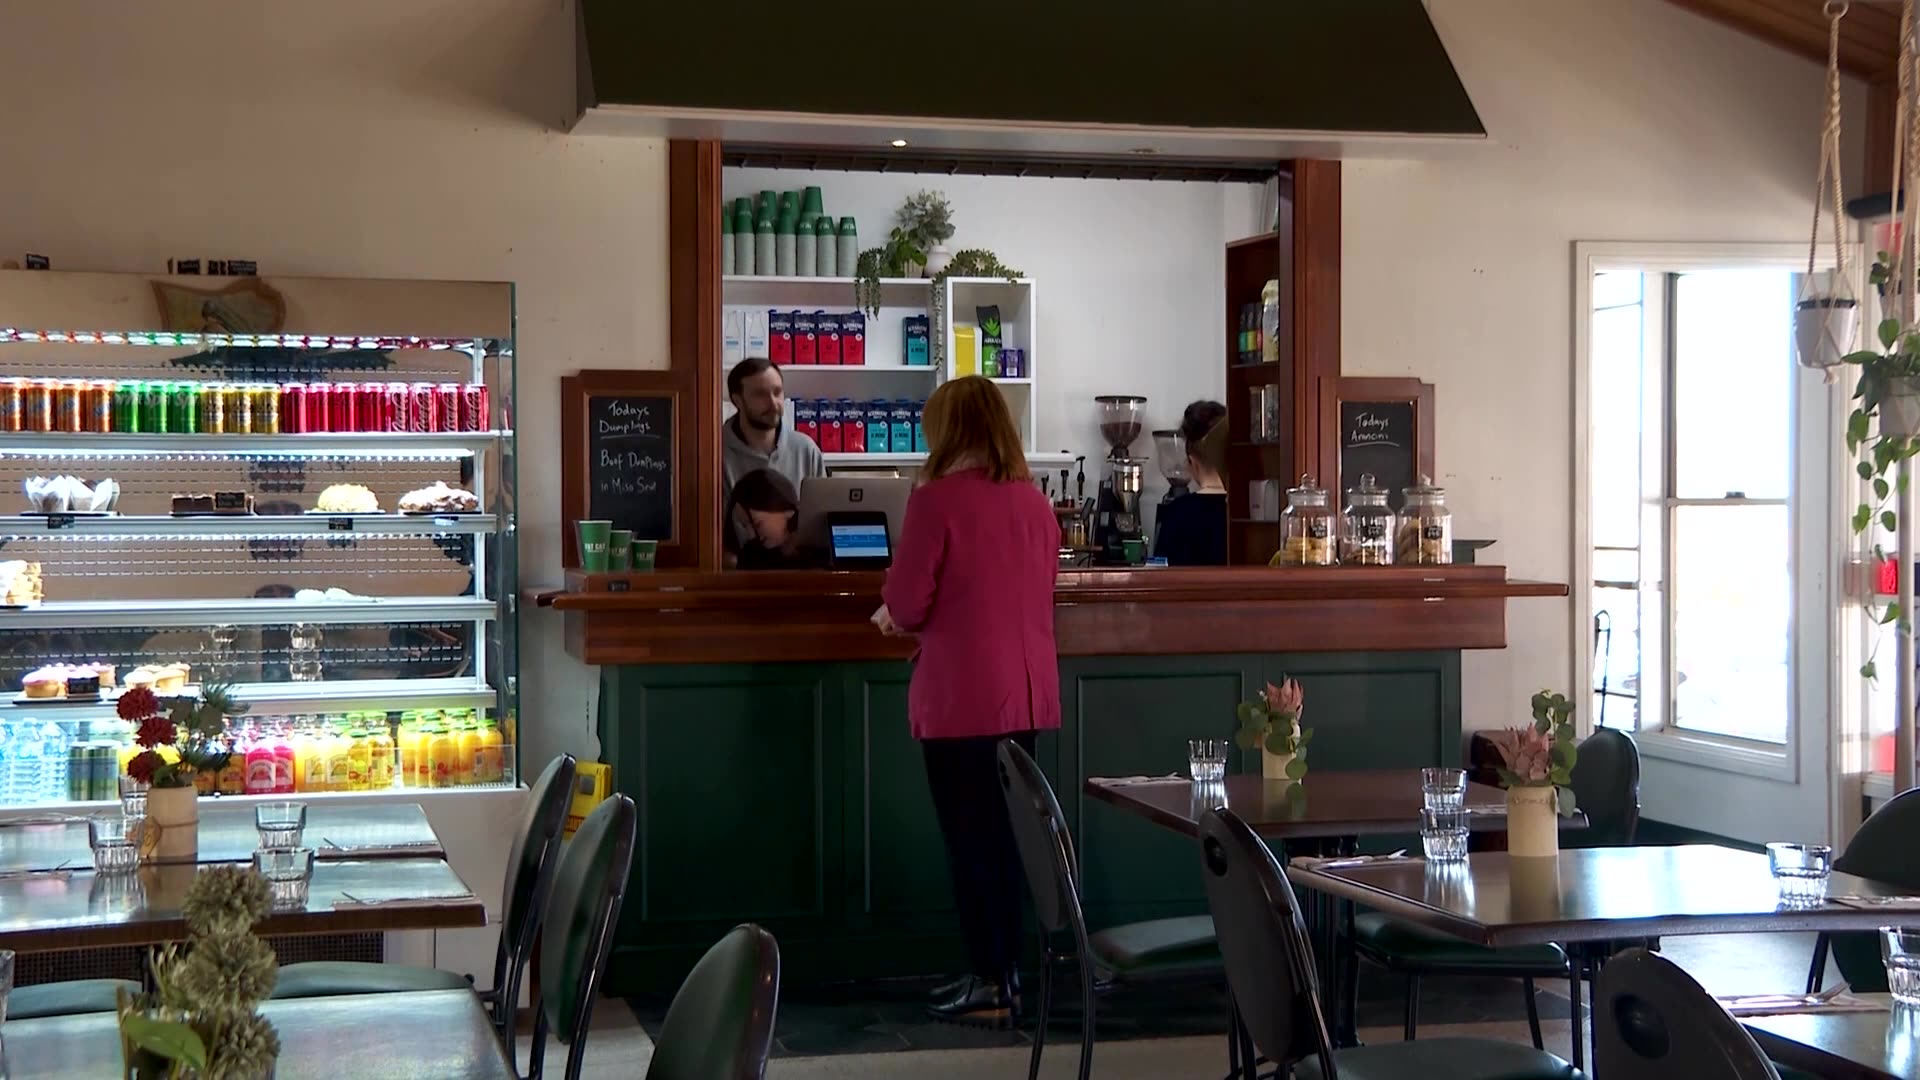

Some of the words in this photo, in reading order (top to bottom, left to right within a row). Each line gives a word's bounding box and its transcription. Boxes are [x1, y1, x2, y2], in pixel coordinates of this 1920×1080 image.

[608, 400, 650, 421] Todays
[599, 419, 651, 434] Dumplings
[1355, 412, 1389, 431] Todays
